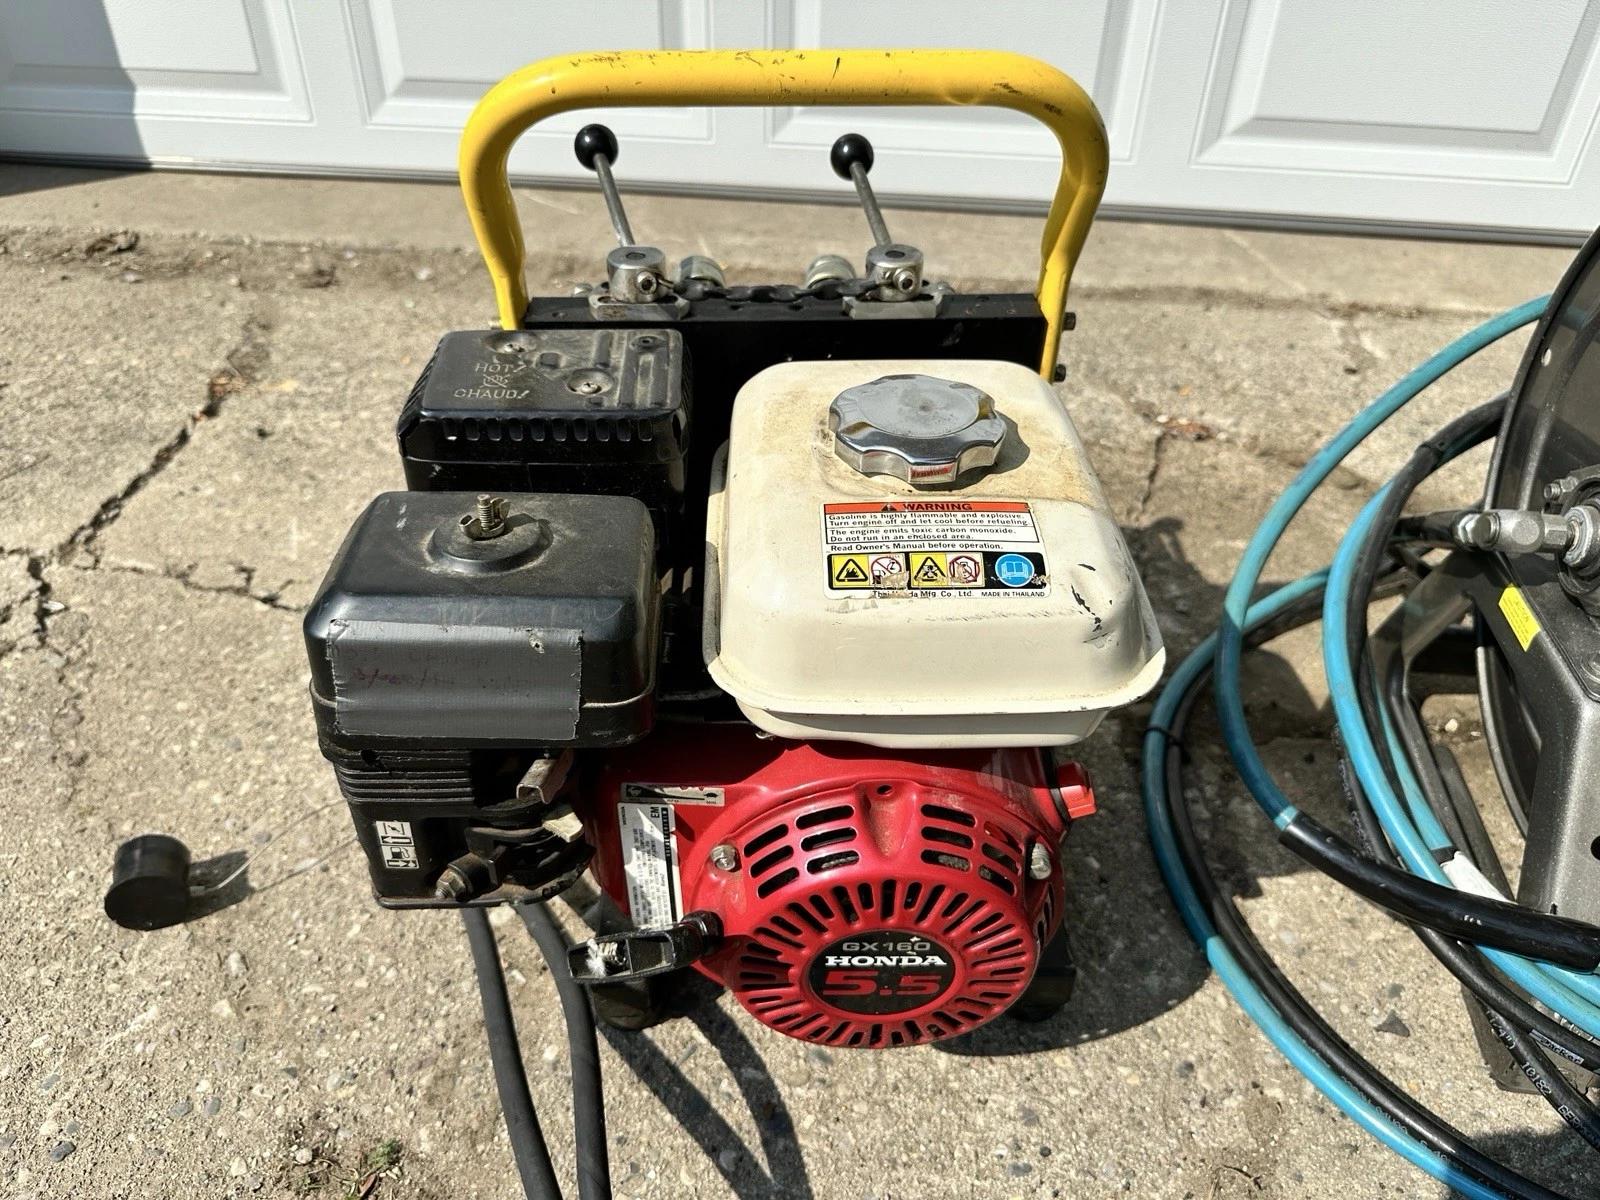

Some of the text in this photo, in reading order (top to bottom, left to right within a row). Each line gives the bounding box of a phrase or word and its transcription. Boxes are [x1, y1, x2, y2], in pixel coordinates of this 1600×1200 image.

[454, 388, 530, 399] CHAUD!
[902, 503, 973, 511] WARNING
[980, 512, 1025, 520] explosive.
[850, 528, 880, 536] engine
[855, 543, 890, 551] Owner's
[892, 542, 925, 550] Manual
[959, 542, 1004, 550] operation.
[650, 806, 660, 819] EM
[824, 955, 948, 967] HONDA
[822, 970, 942, 996] 5.5
